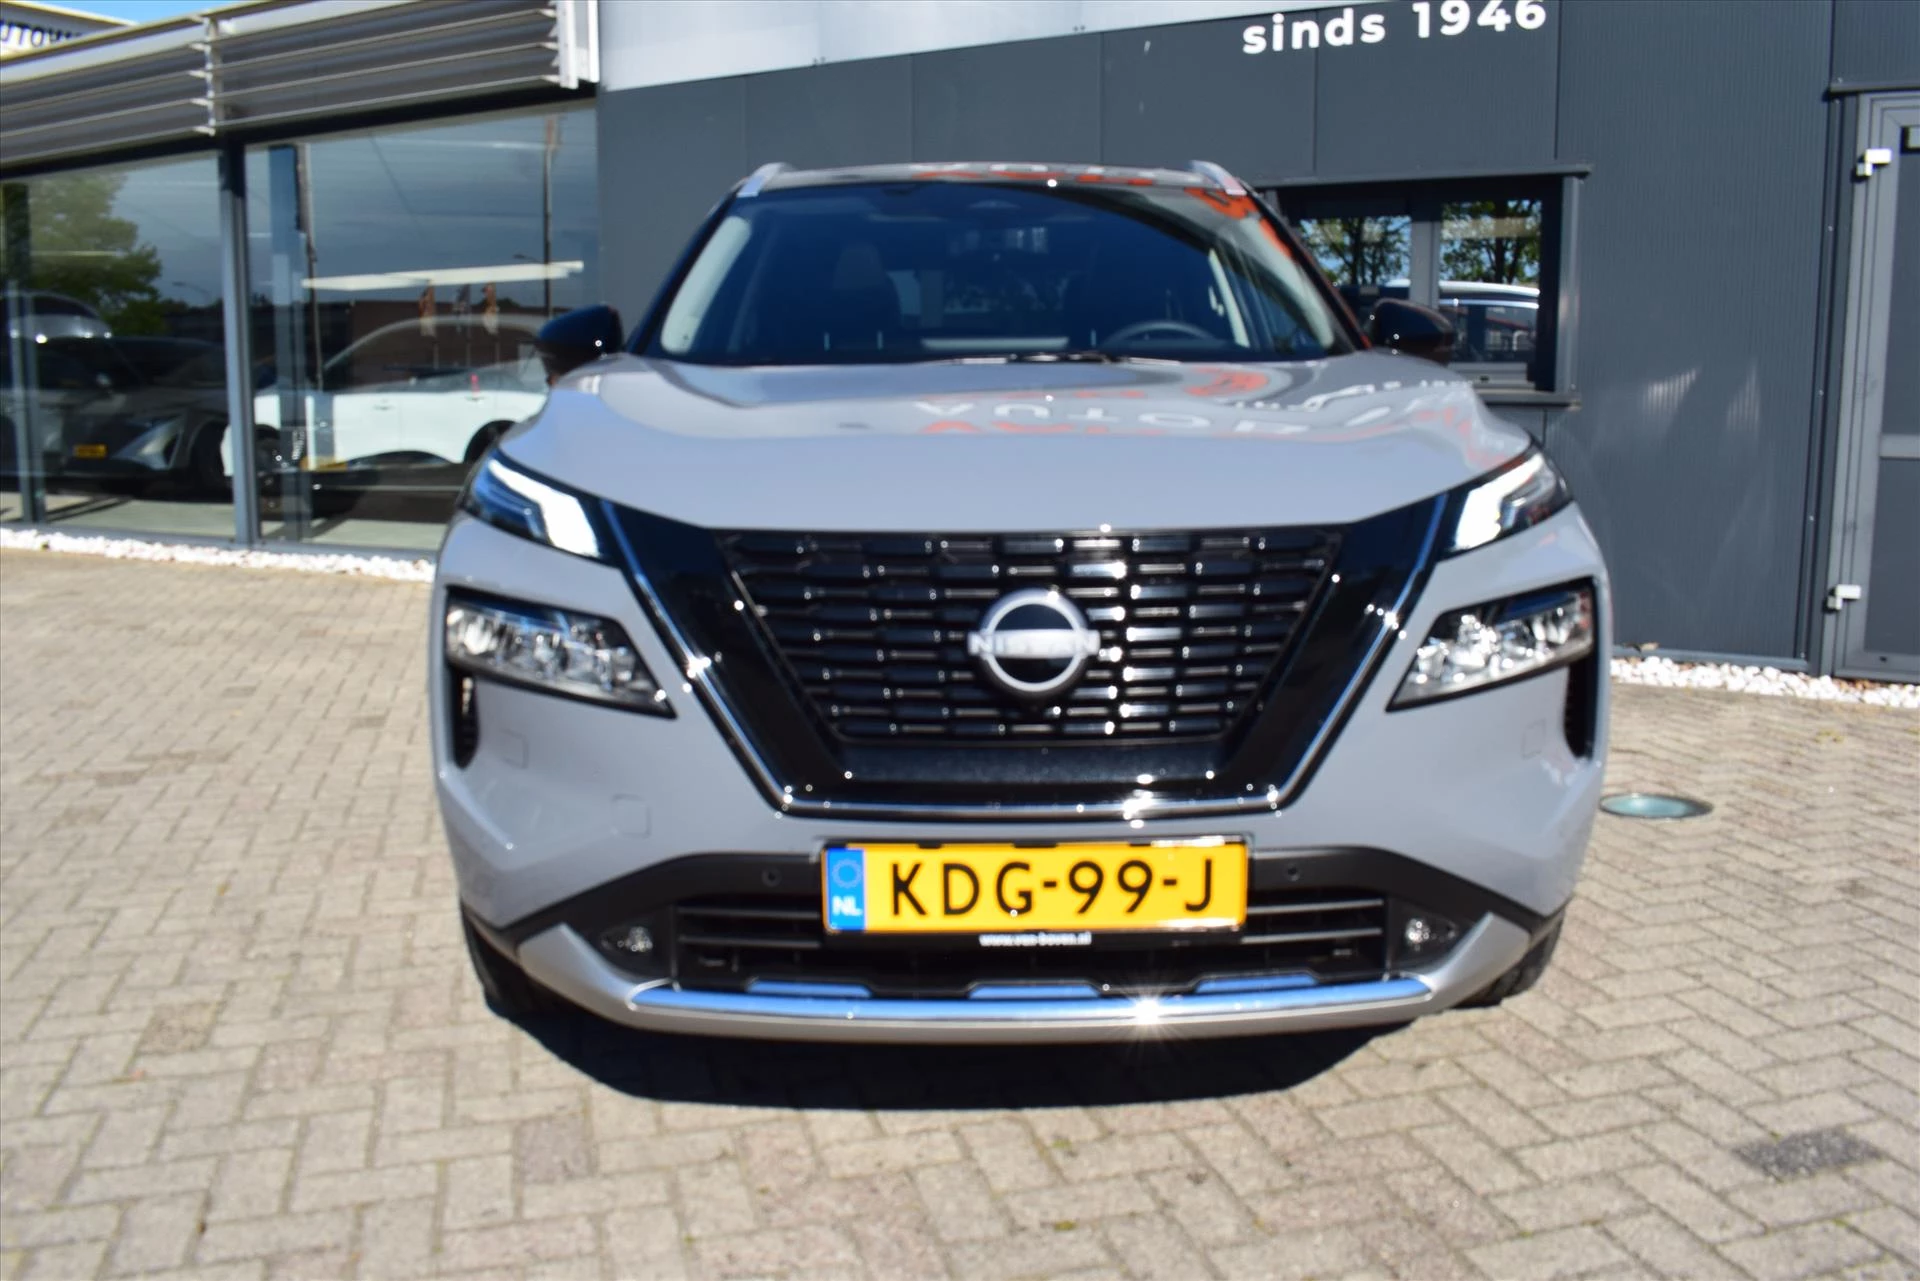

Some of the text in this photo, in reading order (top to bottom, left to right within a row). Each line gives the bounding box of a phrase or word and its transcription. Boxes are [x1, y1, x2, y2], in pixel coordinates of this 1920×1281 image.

[1242, 0, 1547, 54] sinds 1946
[832, 895, 863, 917] NL
[892, 858, 1213, 916] KDG-99-J
